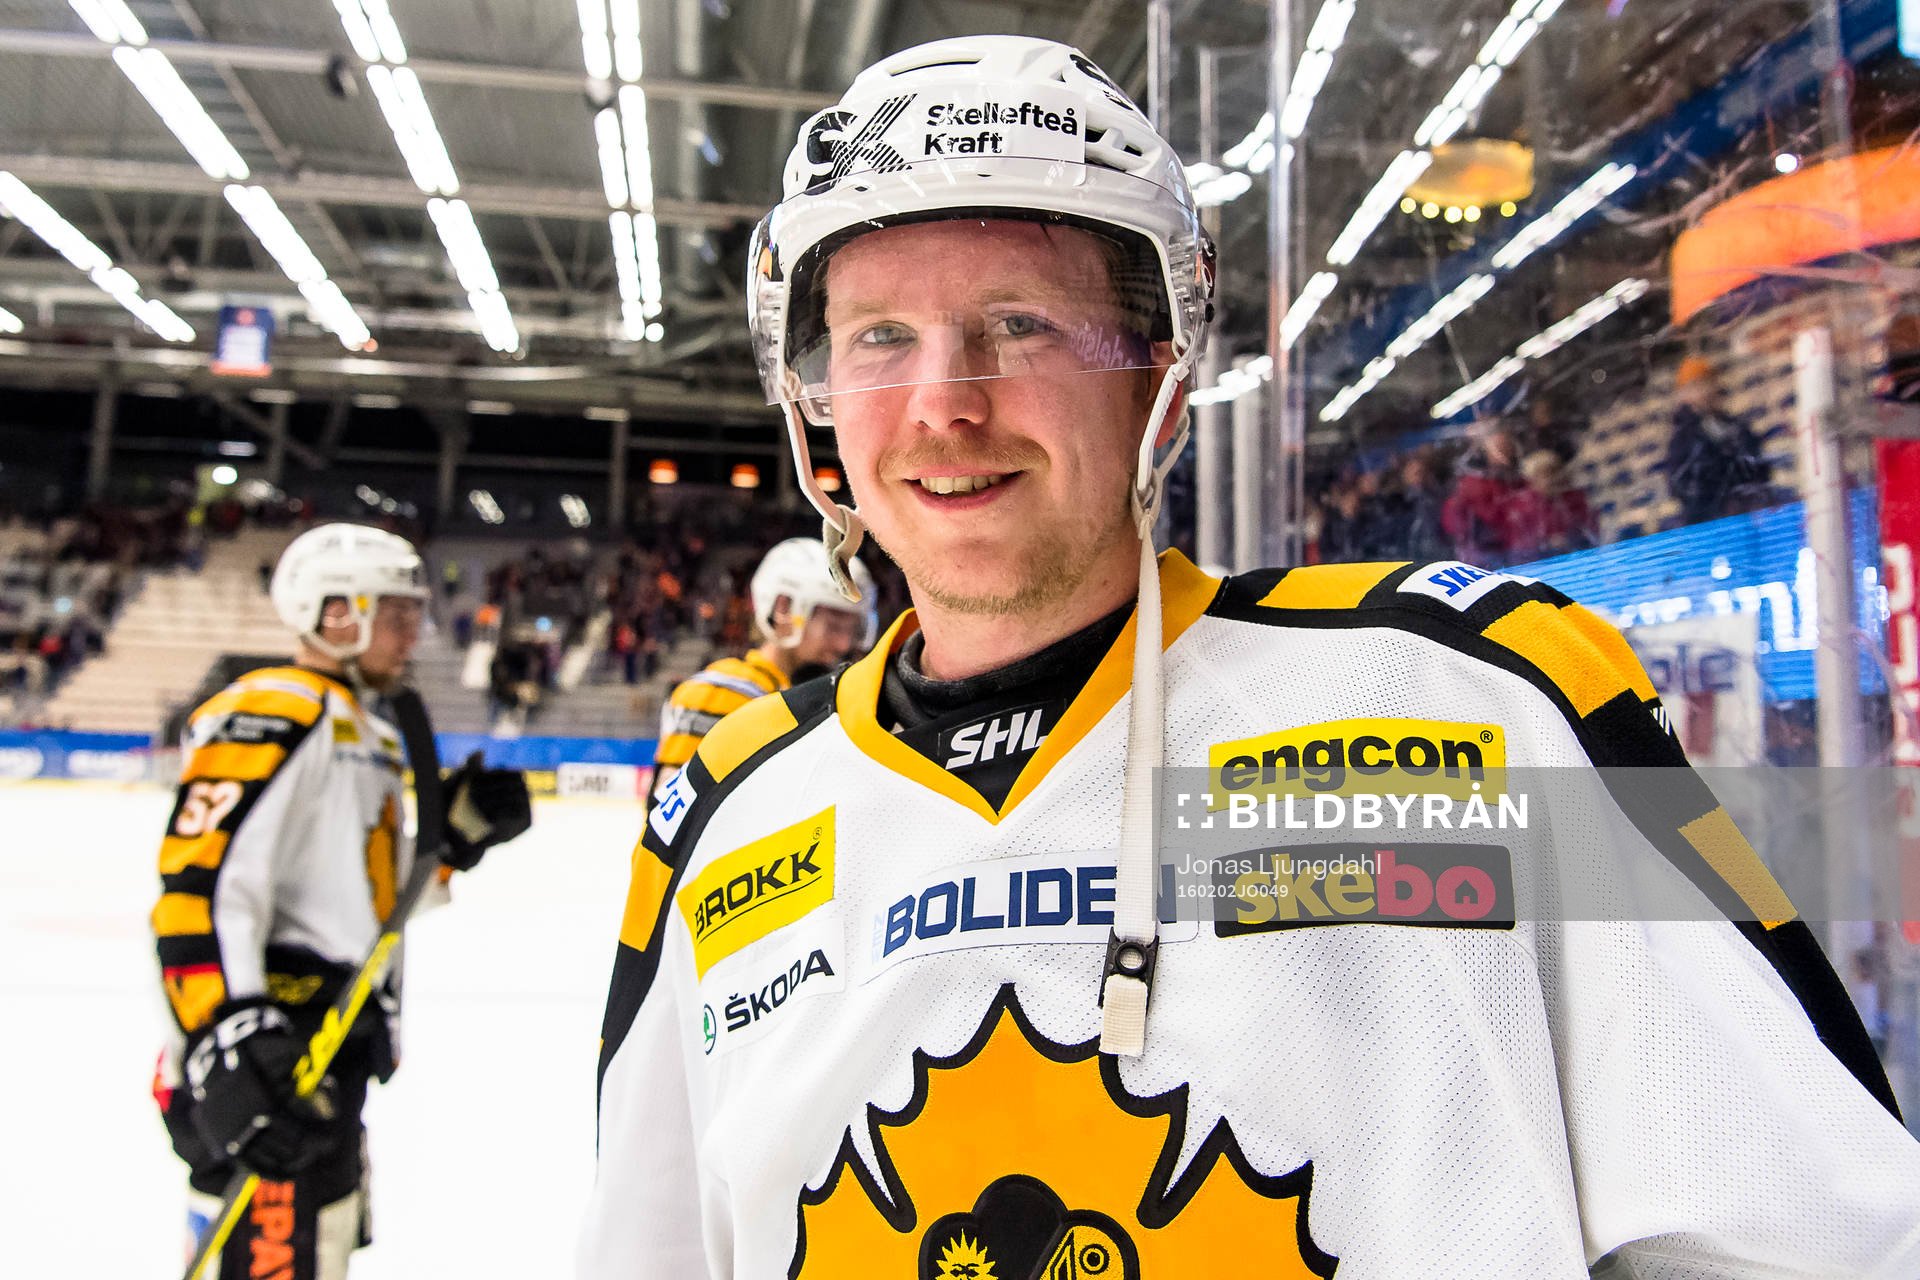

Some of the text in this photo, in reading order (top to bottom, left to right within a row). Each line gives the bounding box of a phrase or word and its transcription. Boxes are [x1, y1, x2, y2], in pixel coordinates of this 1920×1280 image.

[924, 131, 1003, 156] Kraft
[926, 102, 1078, 136] Skellefteå
[945, 709, 1049, 770] SHL
[1220, 735, 1485, 792] engcon
[694, 841, 822, 940] BROKK
[1234, 850, 1497, 925] skebo
[724, 948, 835, 1033] ŠKODA
